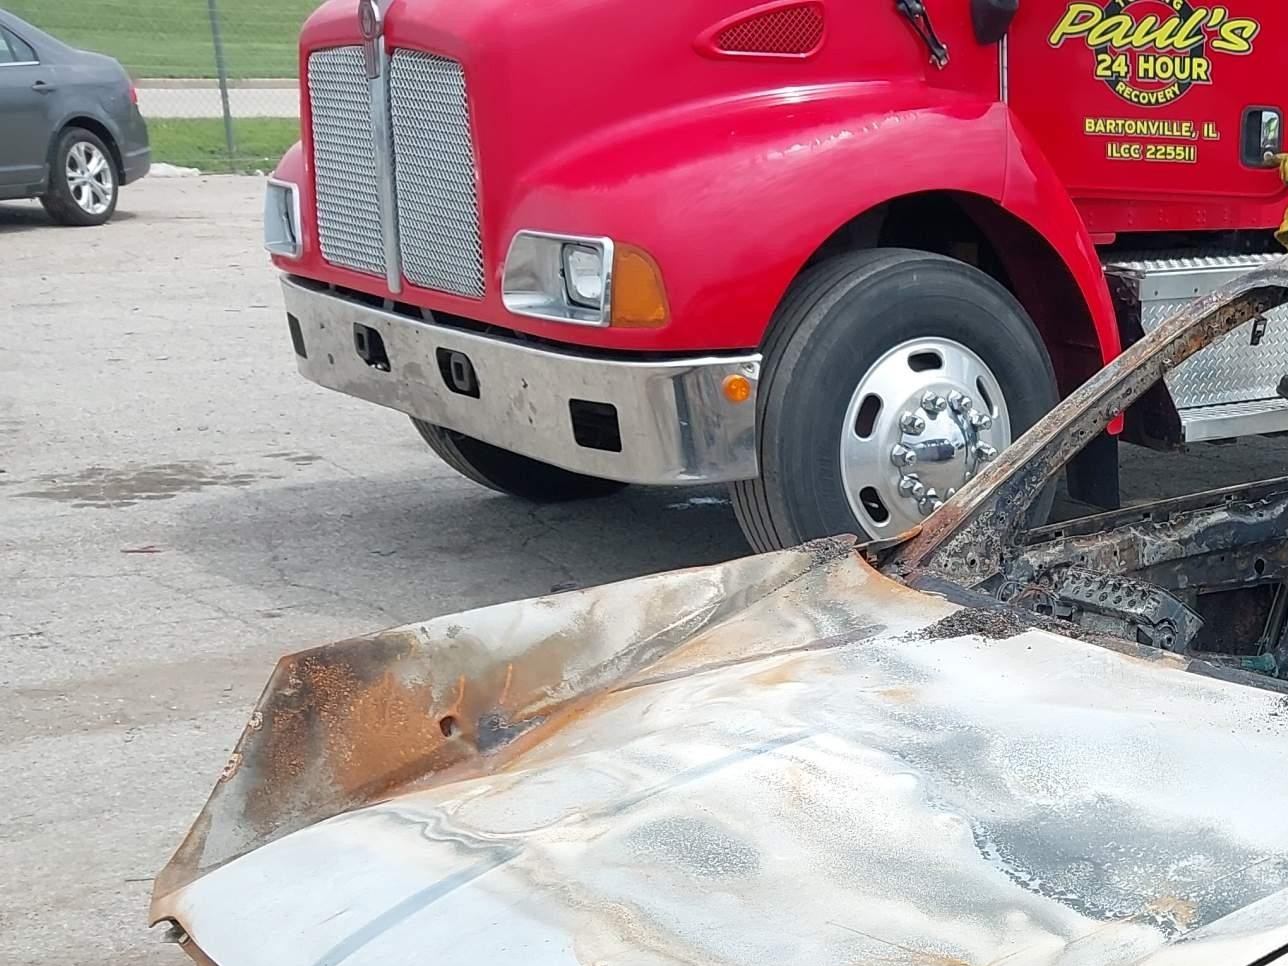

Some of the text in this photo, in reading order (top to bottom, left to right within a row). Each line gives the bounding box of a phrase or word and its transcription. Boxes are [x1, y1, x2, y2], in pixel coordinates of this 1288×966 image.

[1049, 2, 1257, 52] Paul's
[1096, 54, 1208, 80] 24 HOUR
[1116, 81, 1181, 104] RECOVERY
[1085, 118, 1217, 138] BARTONVILLE, IL
[1107, 143, 1195, 160] ILCC 225511
